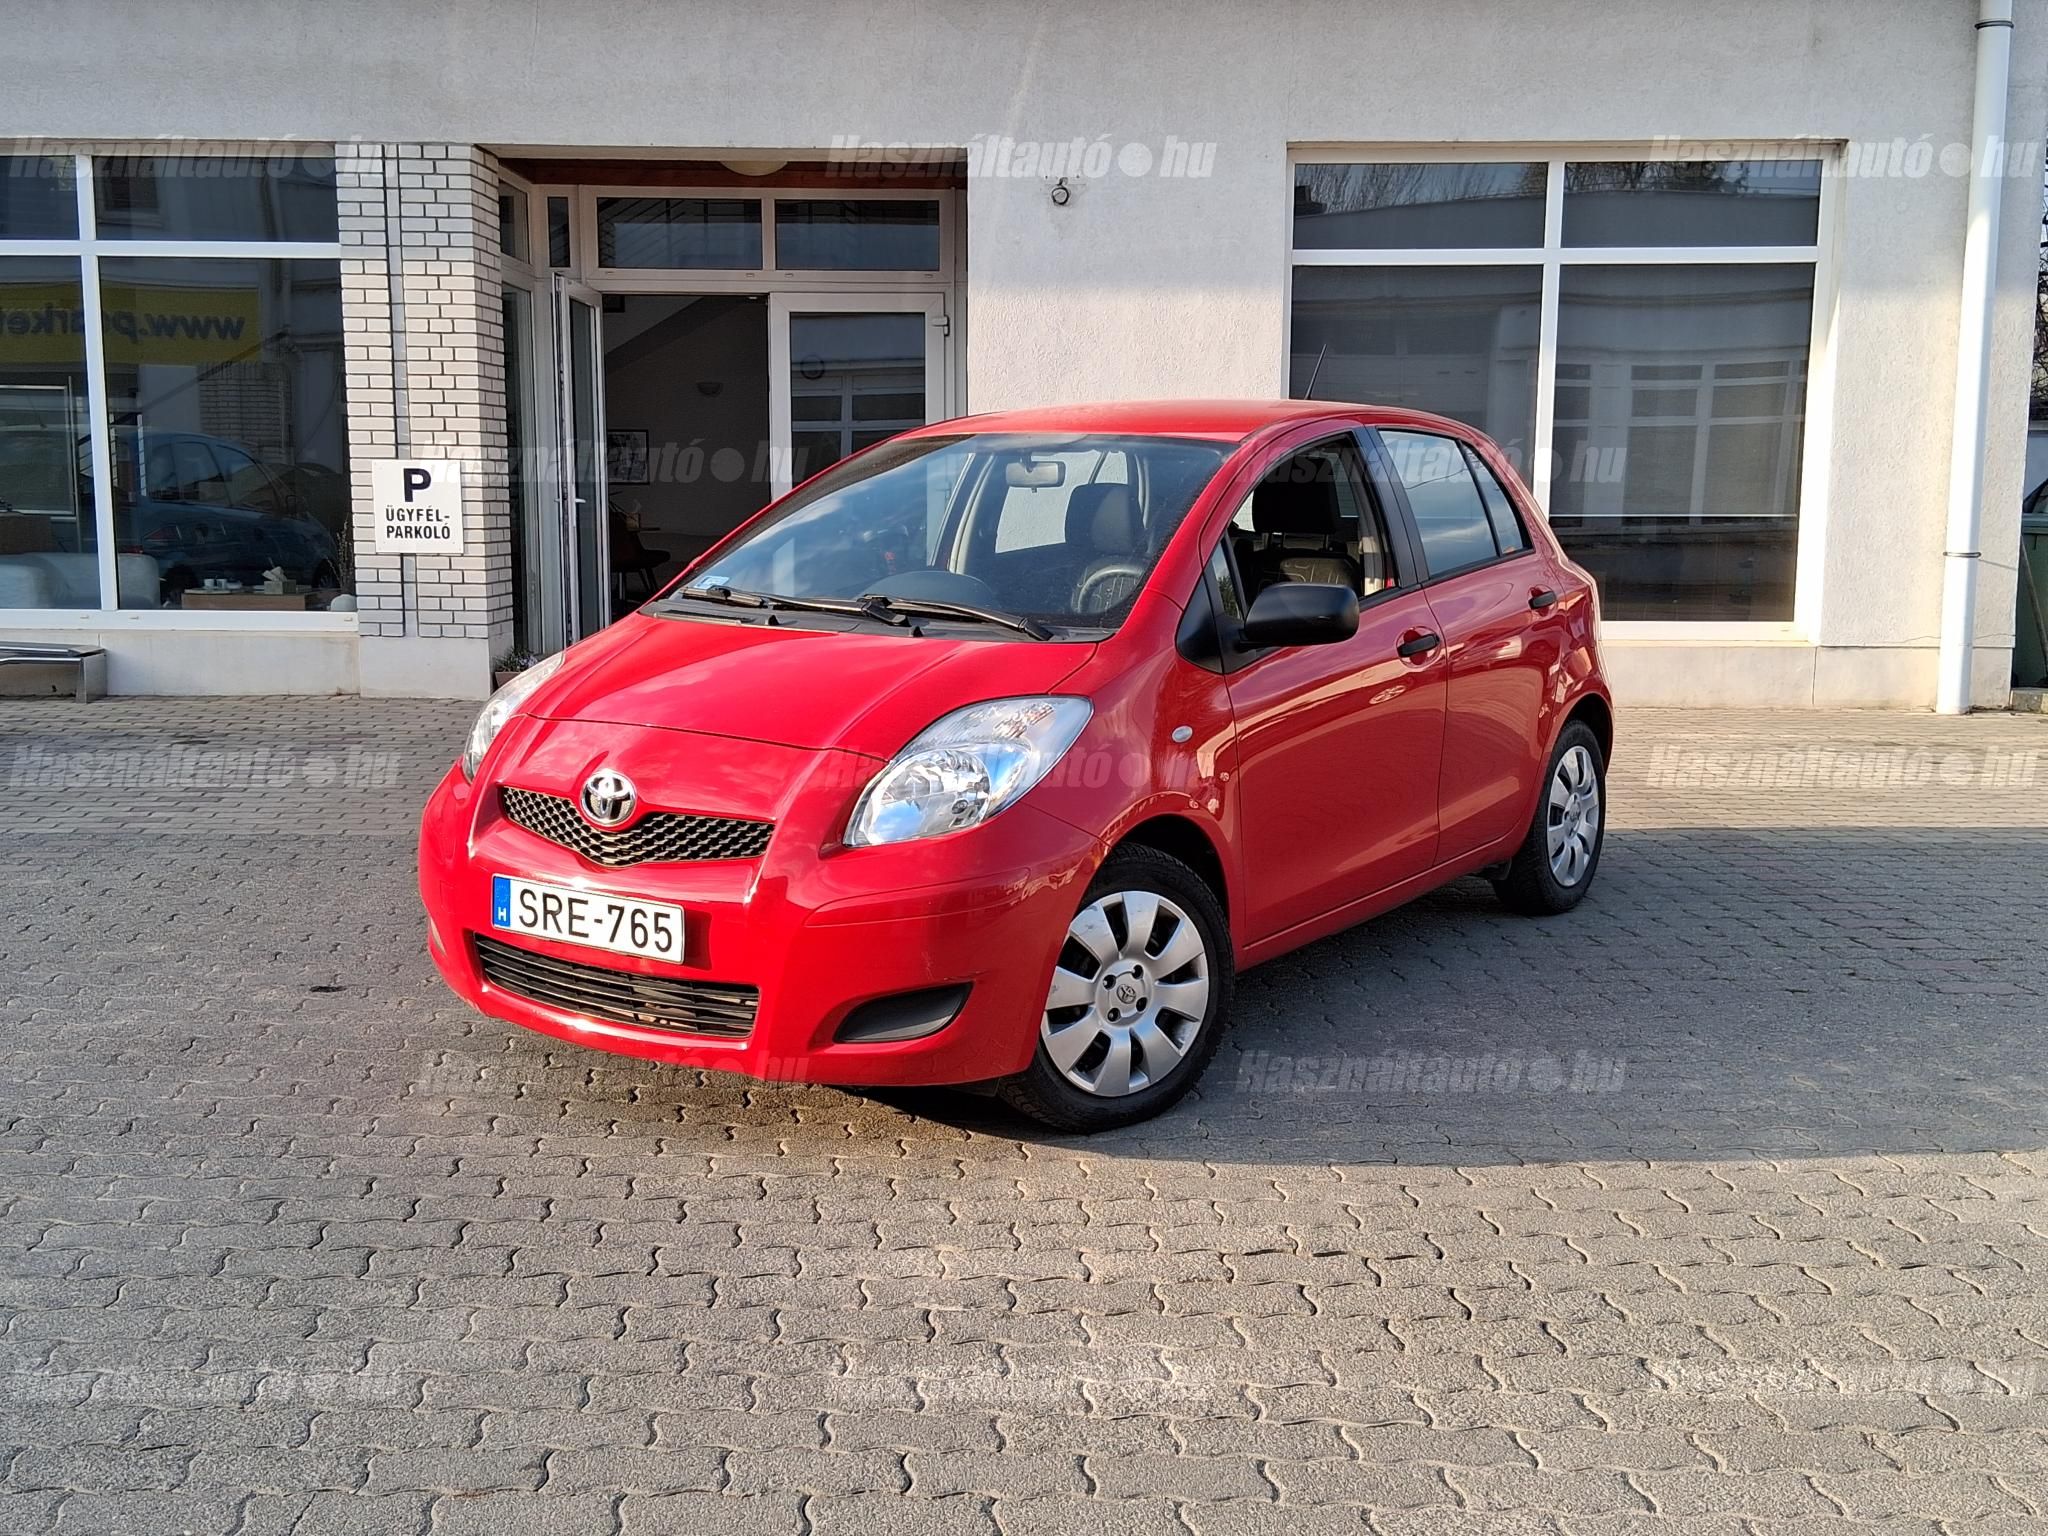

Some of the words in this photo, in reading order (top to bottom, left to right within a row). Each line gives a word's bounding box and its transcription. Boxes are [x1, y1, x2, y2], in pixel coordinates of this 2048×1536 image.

[403, 467, 432, 503] P
[385, 504, 451, 522] ÜGYFÉL-
[386, 522, 451, 540] PARKOLÓ
[497, 907, 507, 922] H
[519, 888, 672, 953] SRE-765
